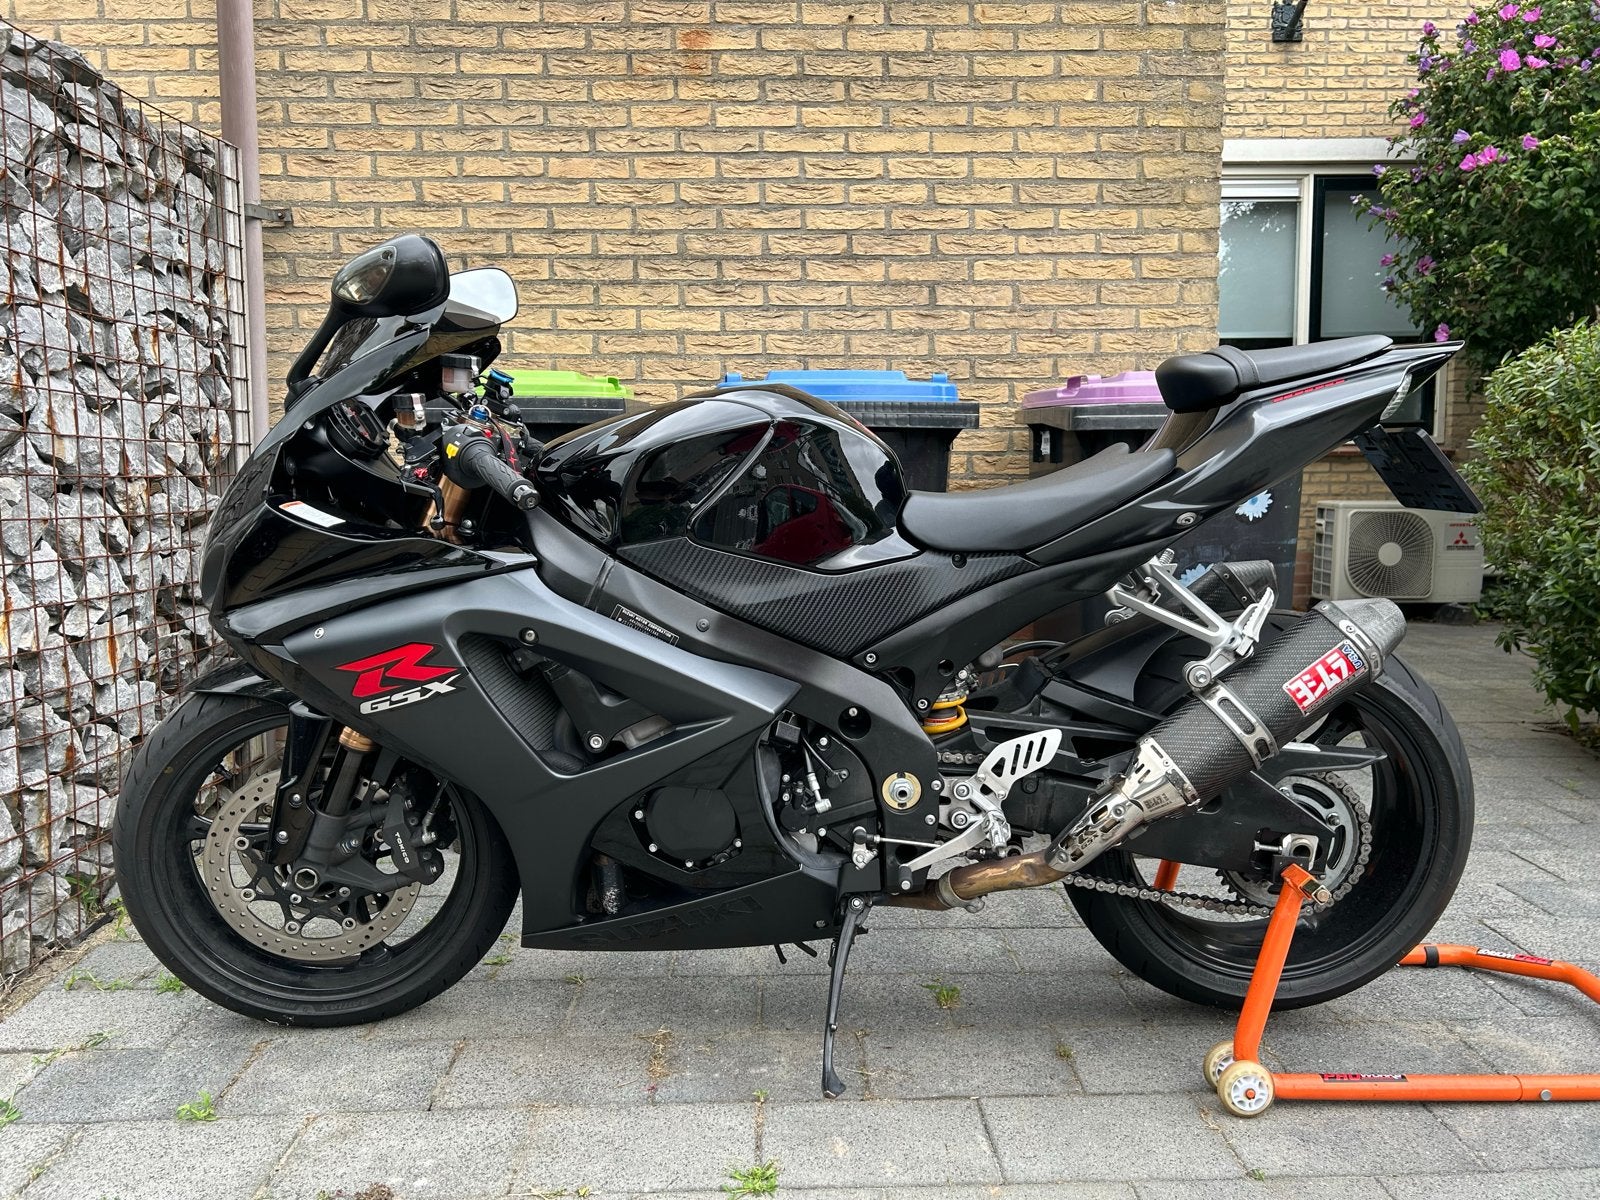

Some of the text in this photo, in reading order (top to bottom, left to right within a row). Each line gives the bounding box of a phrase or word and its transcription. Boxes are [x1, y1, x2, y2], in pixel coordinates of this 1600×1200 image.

[1341, 644, 1363, 670] USA
[360, 673, 461, 715] GSX
[1289, 651, 1350, 708] ヨシムラ
[394, 831, 410, 864] TOKICO
